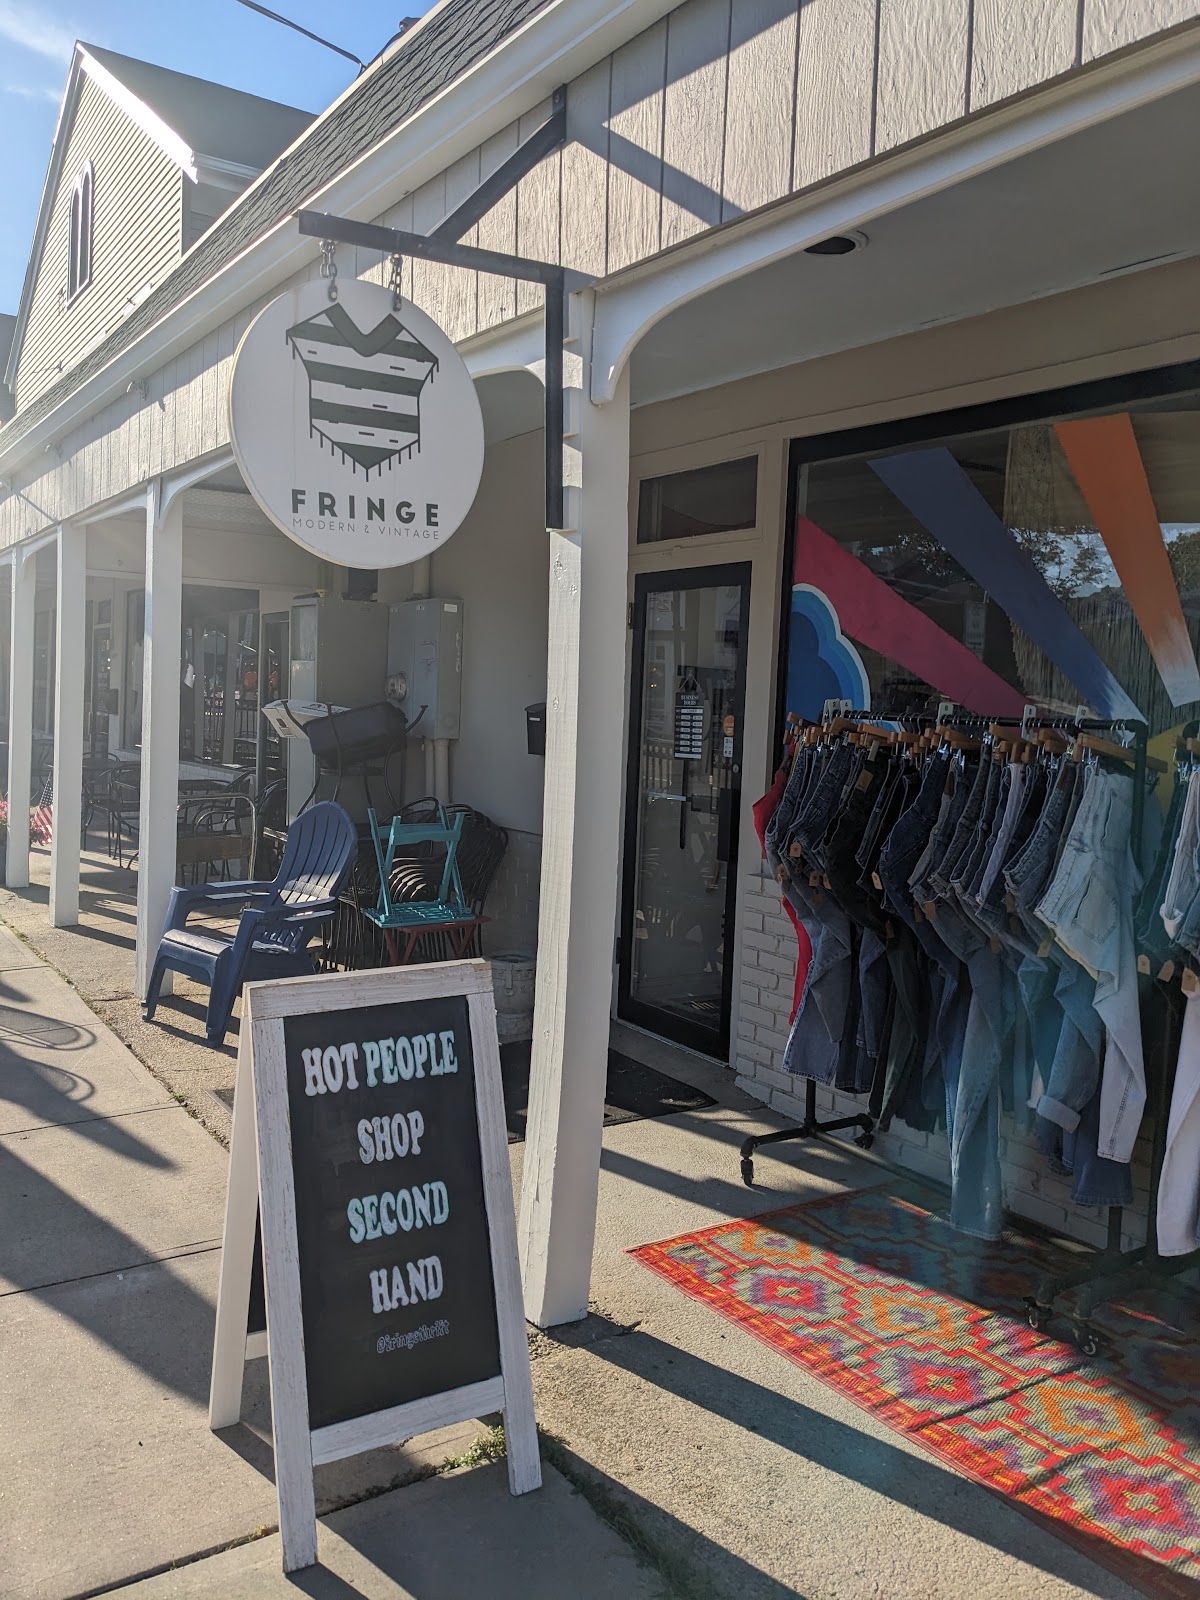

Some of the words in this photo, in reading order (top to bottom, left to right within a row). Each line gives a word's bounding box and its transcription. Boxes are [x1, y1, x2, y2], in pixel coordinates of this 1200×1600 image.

[291, 489, 439, 527] FRINGE
[292, 518, 355, 533] MODERN
[364, 524, 370, 534] &
[378, 526, 439, 540] VINTAGE
[301, 1041, 359, 1097] HOT
[361, 1030, 458, 1088] PEOPLE
[357, 1110, 424, 1165] SHOP
[347, 1181, 450, 1244] SECOND
[369, 1255, 443, 1314] HAND
[376, 1319, 450, 1354] @fringethrift
